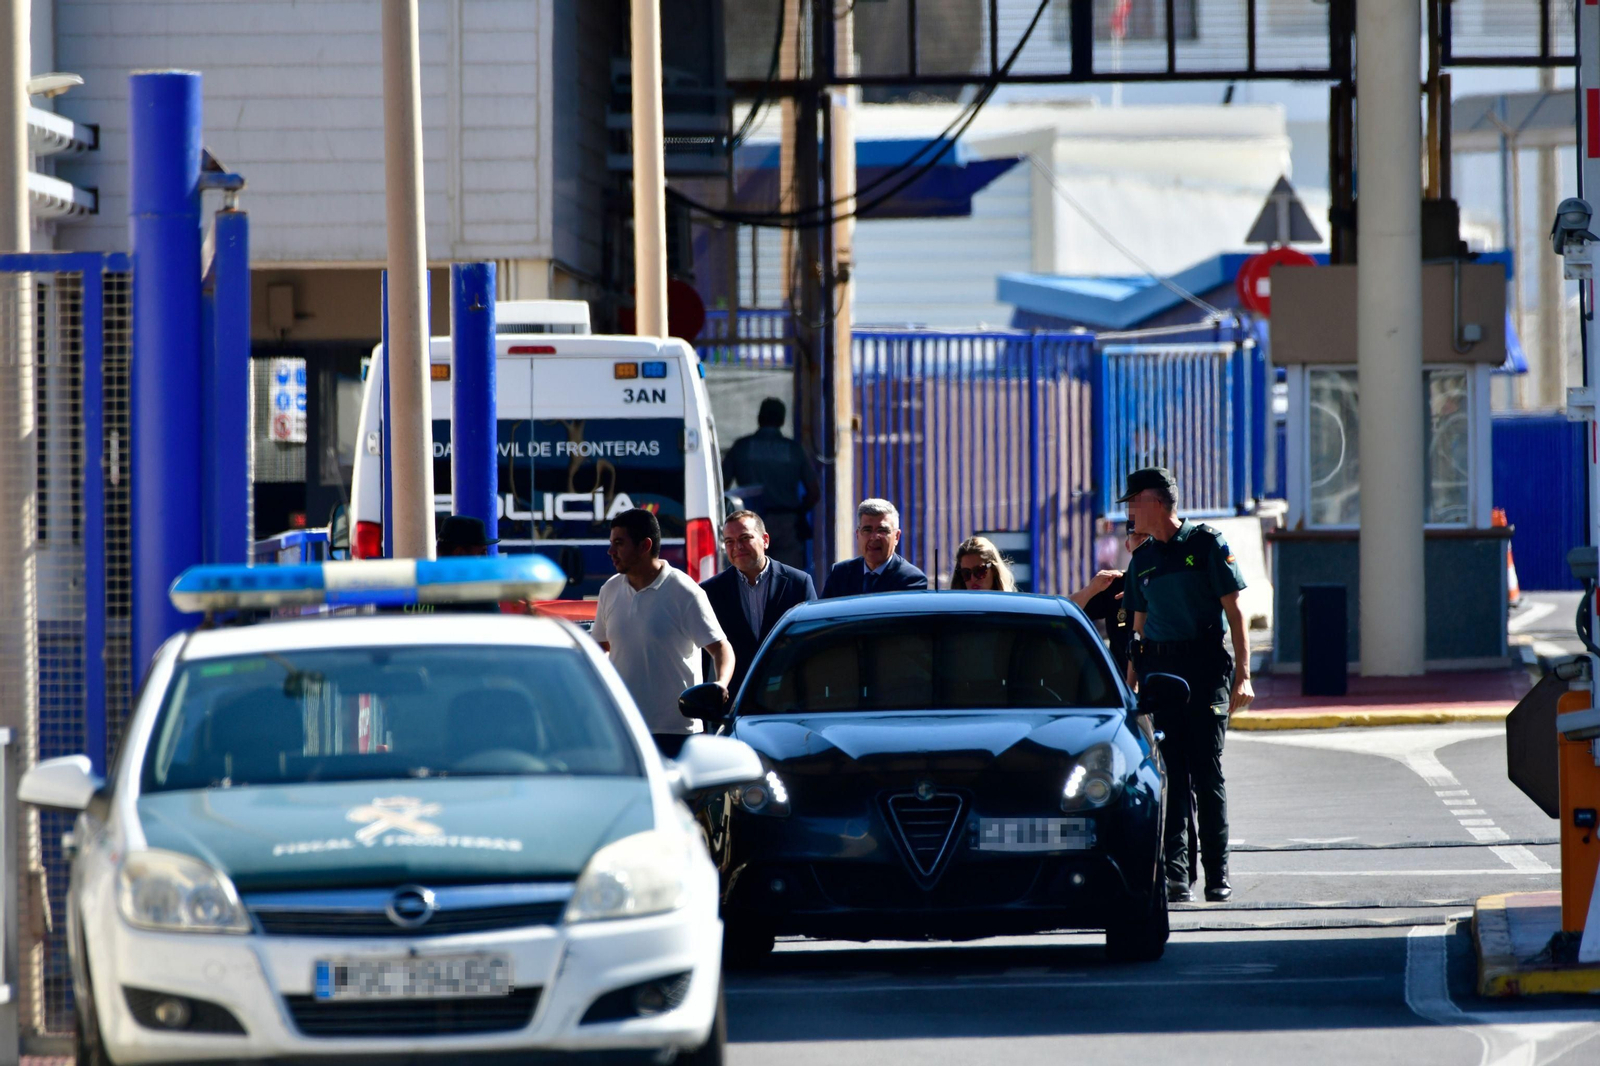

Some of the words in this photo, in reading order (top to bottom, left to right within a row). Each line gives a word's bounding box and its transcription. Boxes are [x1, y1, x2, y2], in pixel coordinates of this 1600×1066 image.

[623, 388, 667, 404] 3AN
[497, 441, 525, 457] VIL
[528, 441, 552, 457] DE
[556, 440, 660, 457] FRONTERAS
[434, 486, 635, 520] LICÍA
